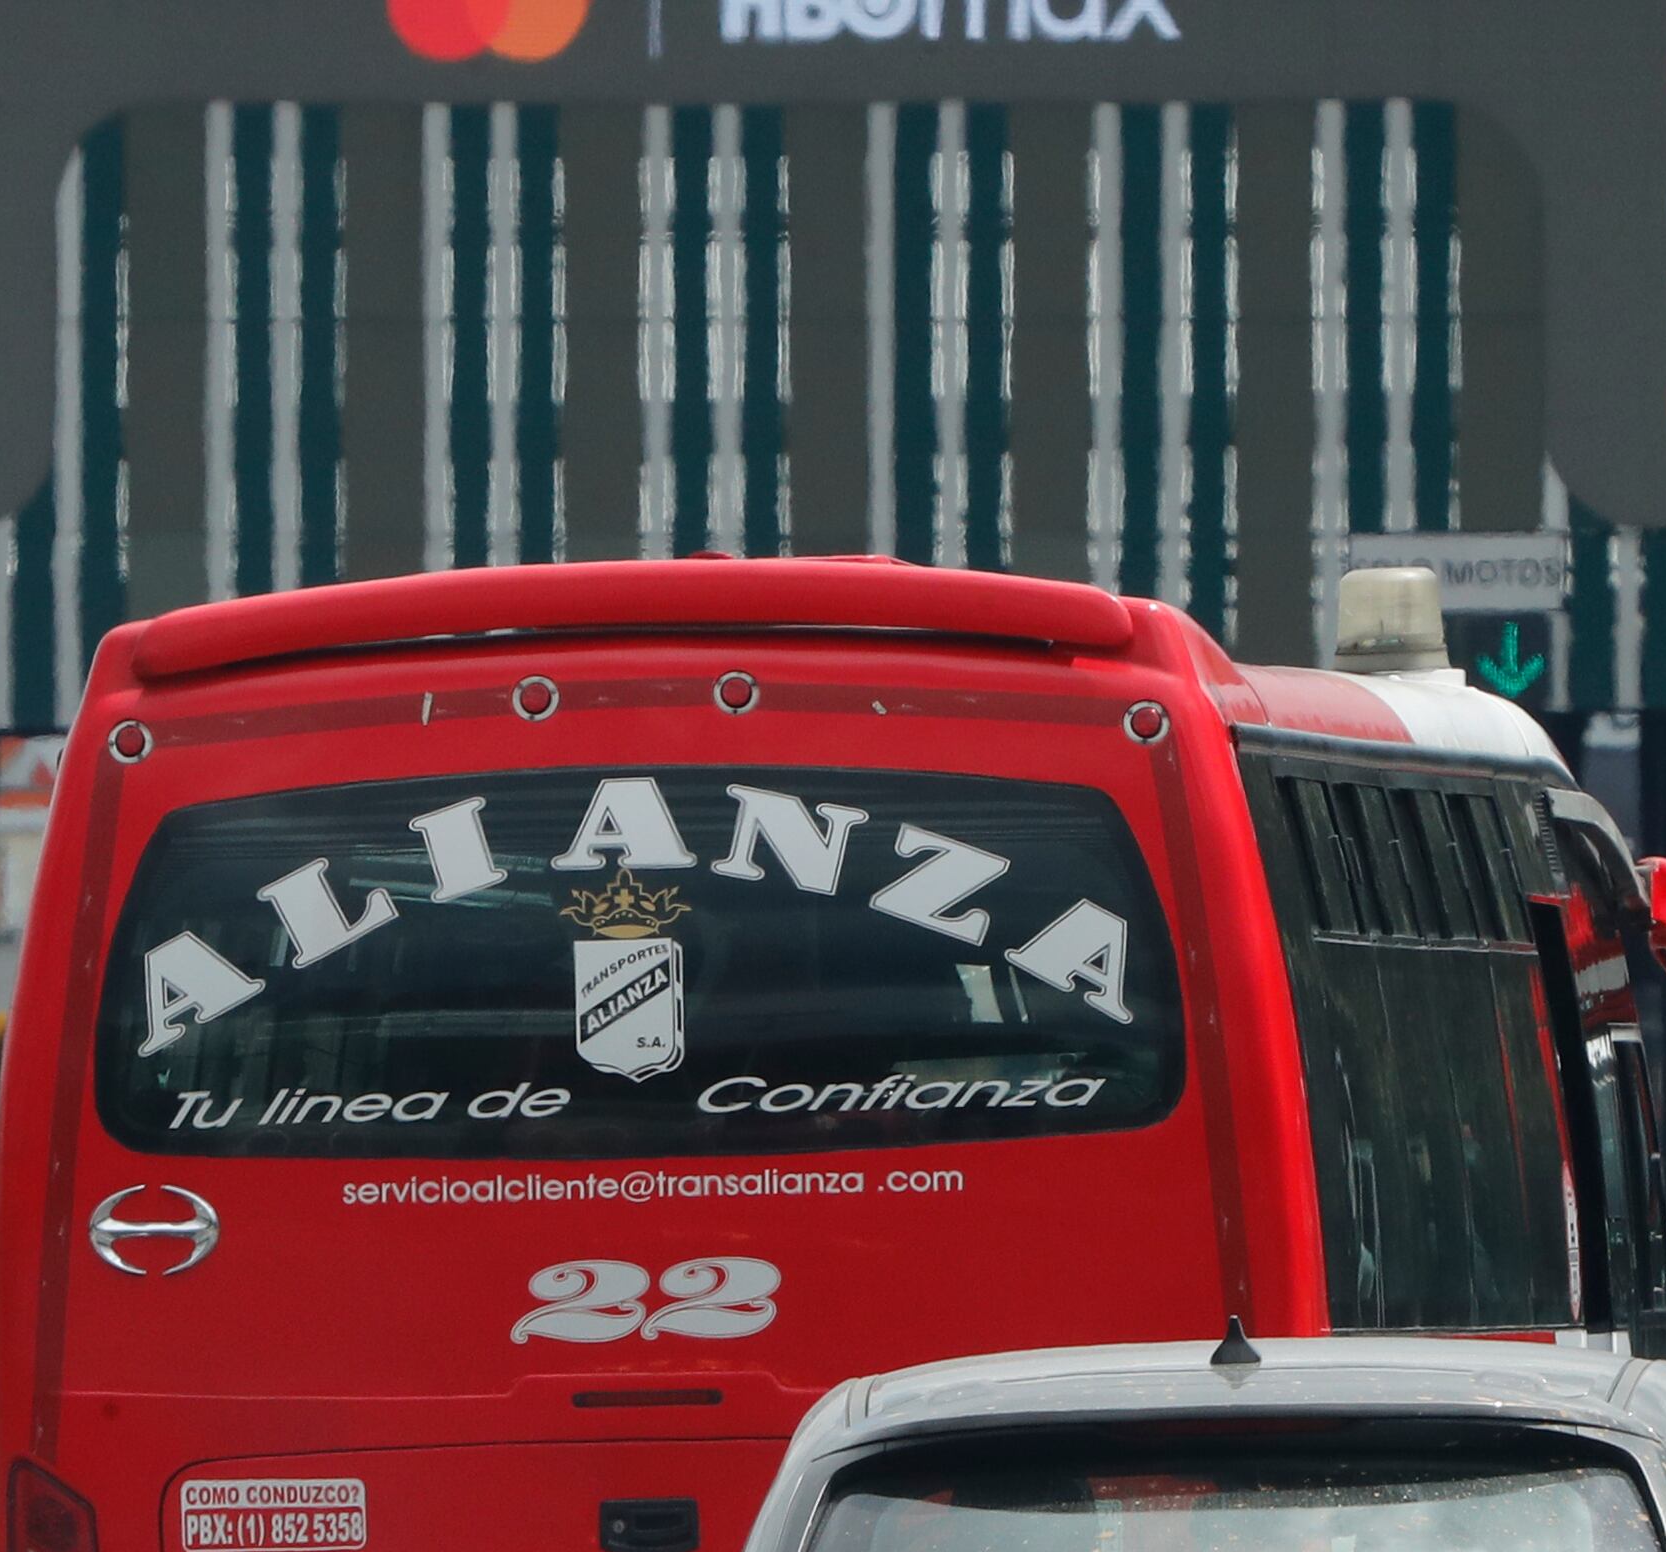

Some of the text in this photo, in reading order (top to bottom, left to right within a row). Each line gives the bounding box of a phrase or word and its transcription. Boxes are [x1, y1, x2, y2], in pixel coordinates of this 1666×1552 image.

[1441, 557, 1562, 587] MOTOS
[138, 776, 1134, 1059] ALIANZA
[581, 943, 669, 998] TRANSPORTES
[587, 967, 669, 1035] ALIANZA
[636, 1036, 667, 1049] S.A.
[169, 1073, 1107, 1130] Tu linea de Confianza
[342, 1168, 964, 1205] servicioalcliente@transalianza .com
[509, 1256, 782, 1344] 22
[185, 1484, 360, 1506] COMO CONDUZCO?
[186, 1511, 363, 1547] PBX: (1) 852 5358
